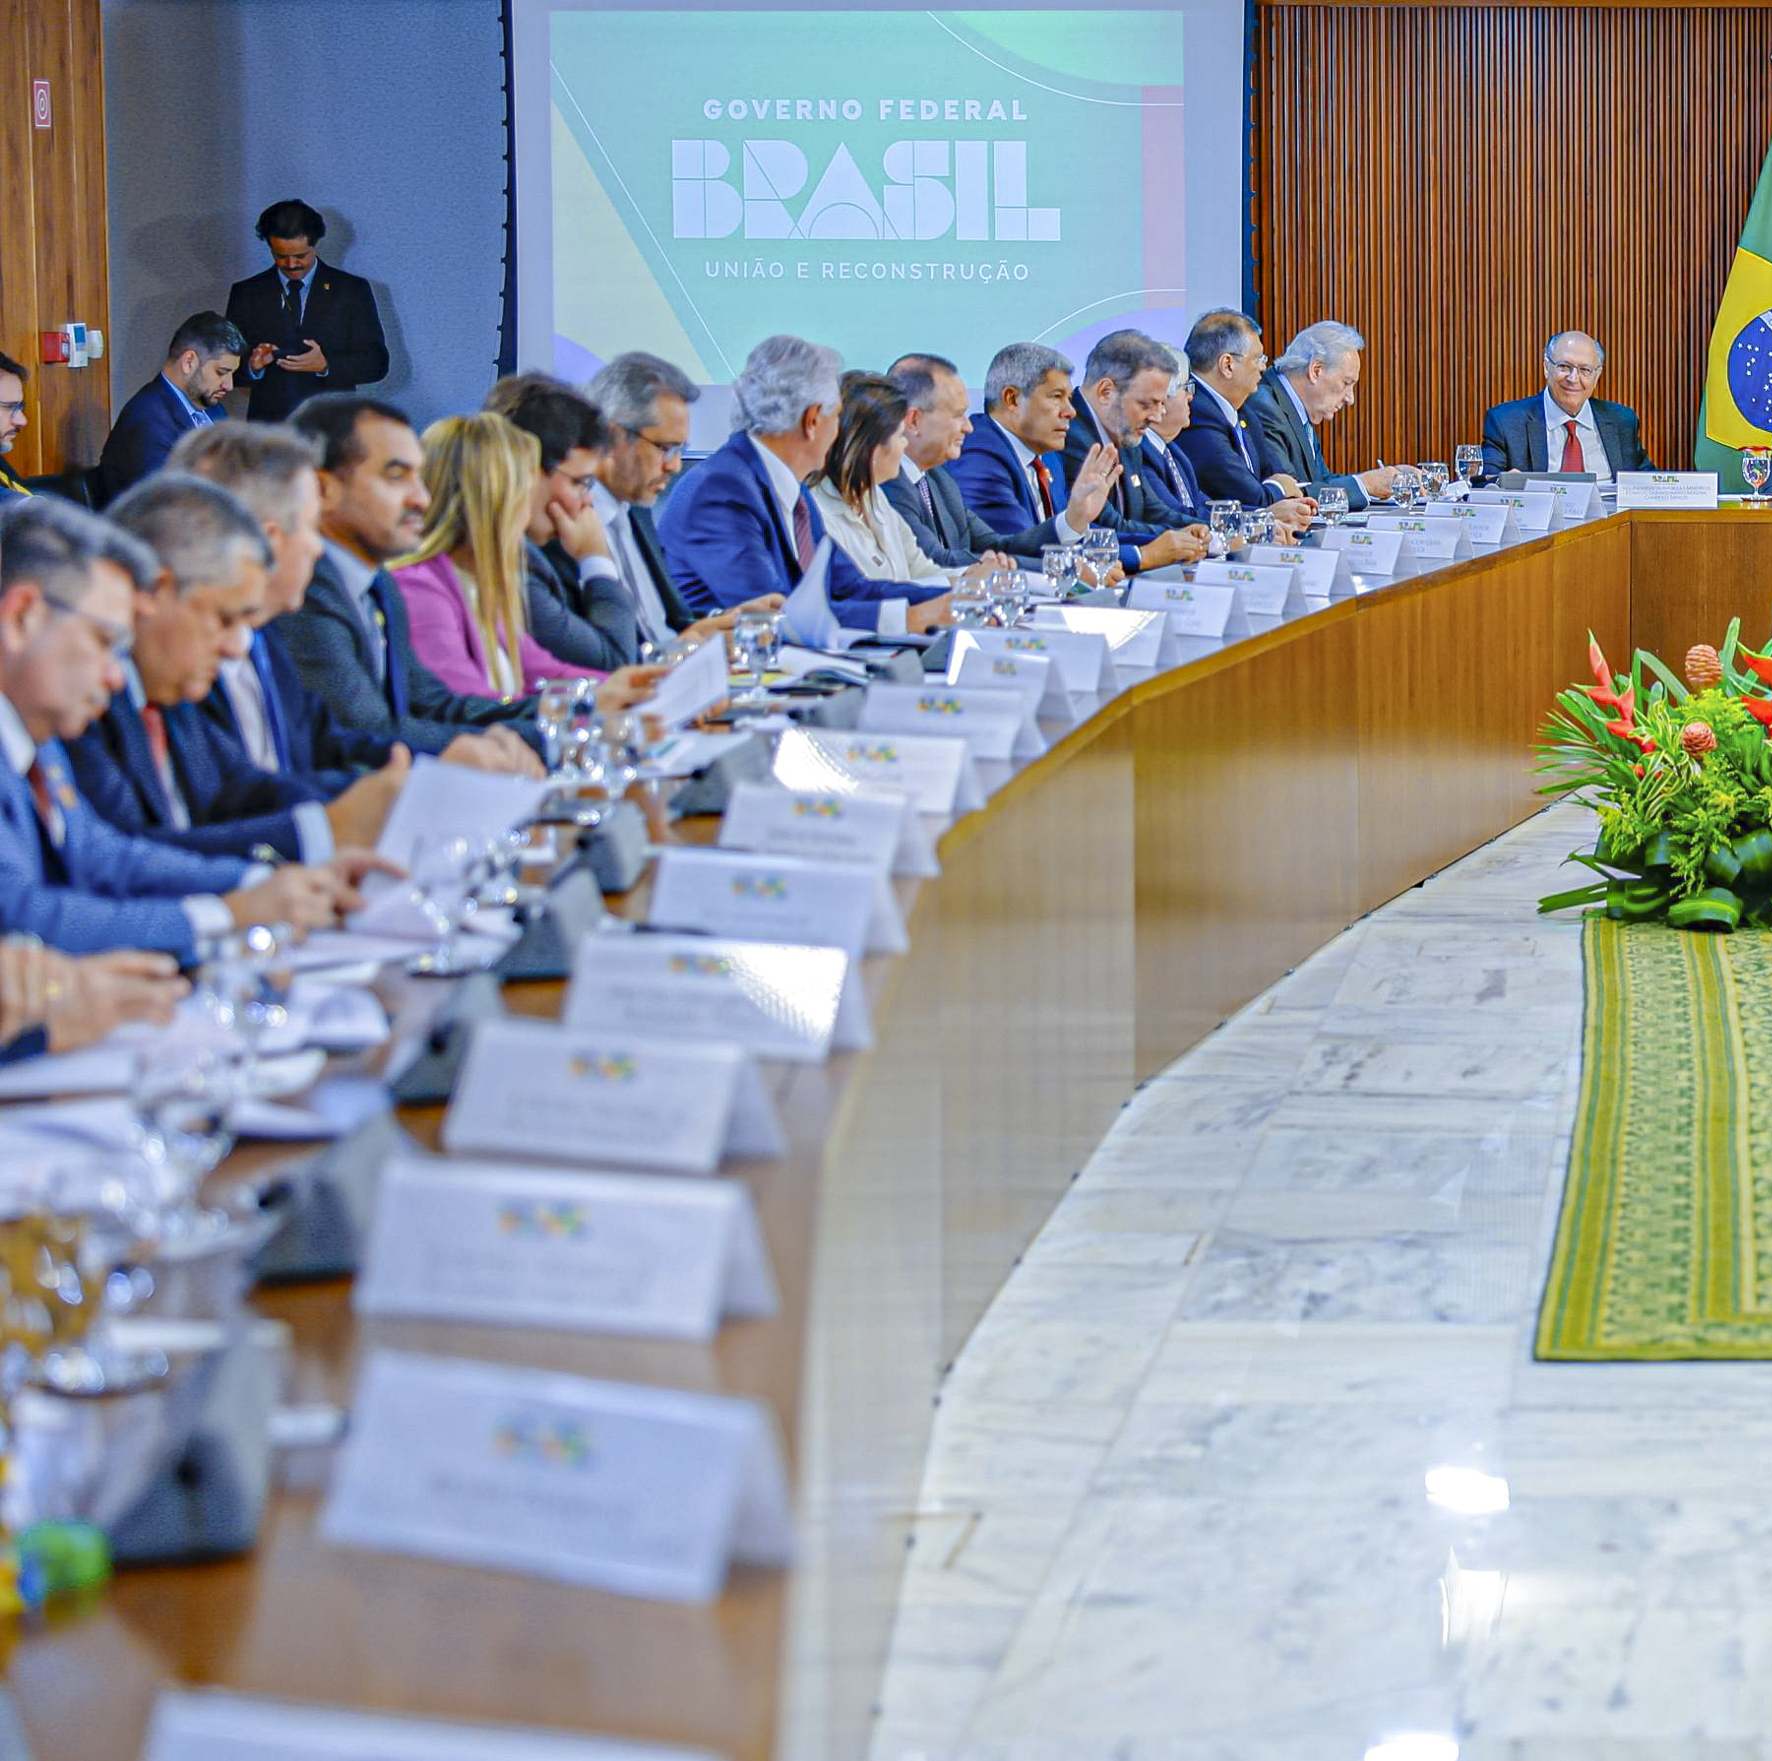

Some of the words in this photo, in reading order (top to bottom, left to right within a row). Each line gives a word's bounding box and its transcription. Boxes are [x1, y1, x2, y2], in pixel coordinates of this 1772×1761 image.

[703, 99, 863, 121] GOVERNO
[879, 99, 1028, 121] FEDERAL
[671, 139, 1061, 241] BRASIL
[705, 256, 785, 279] UNIÃO
[797, 262, 811, 279] E
[822, 257, 1030, 284] RECONSTRUÇÃO
